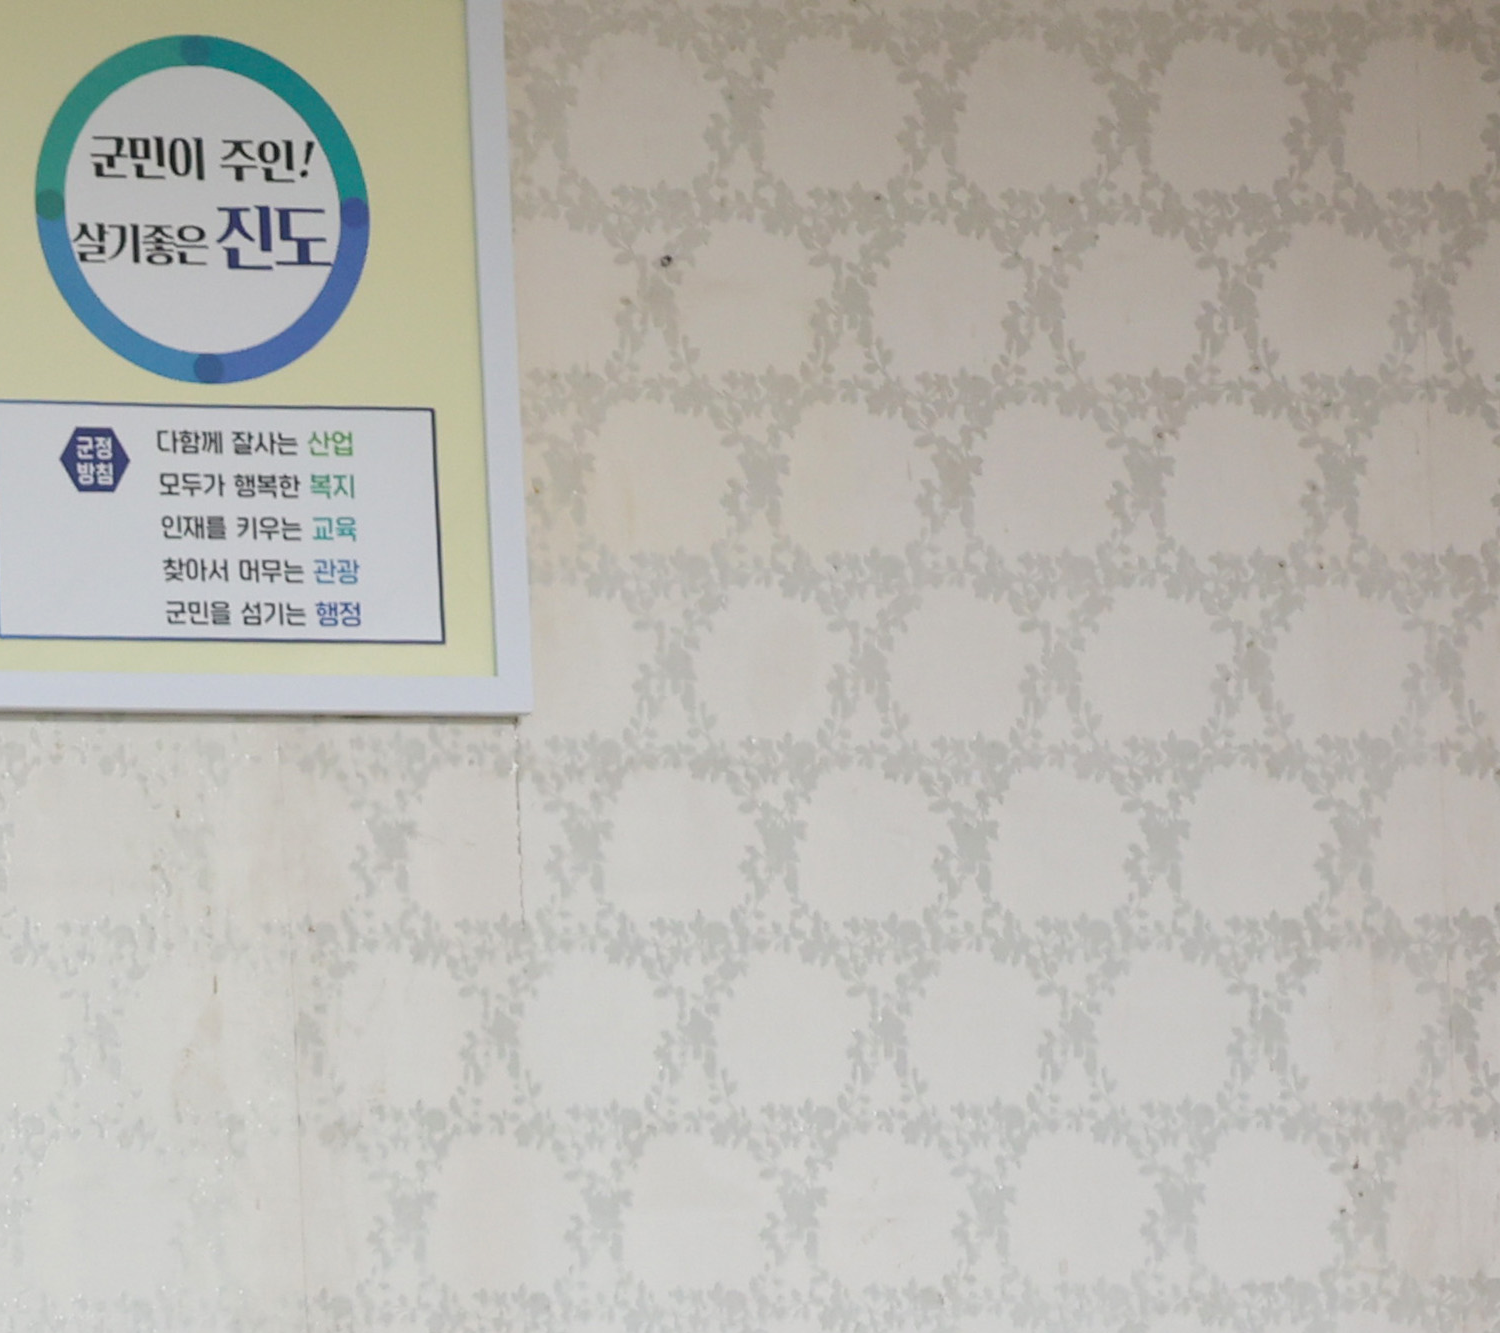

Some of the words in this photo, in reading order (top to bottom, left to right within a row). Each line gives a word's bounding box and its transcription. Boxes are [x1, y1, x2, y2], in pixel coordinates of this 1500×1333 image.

[90, 136, 205, 181] 군민이
[221, 139, 316, 184] 주인!
[71, 223, 208, 267] 살기좋은
[216, 205, 333, 271] 진도
[75, 435, 113, 460] 군정
[156, 431, 224, 456] 다함께
[232, 432, 299, 456] 잘사는
[307, 431, 354, 457] 산업
[75, 462, 114, 486] 방침
[159, 473, 226, 498] 모두가
[234, 474, 300, 500] 행복한
[309, 474, 356, 500] 복지
[161, 515, 227, 541] 인재를
[236, 516, 303, 542] 키우는
[312, 517, 358, 543] 교육
[163, 557, 229, 583] 찾아서
[239, 559, 305, 584] 머무는
[313, 559, 360, 586] 관광
[165, 601, 231, 626] 군민을
[241, 602, 307, 627] 섬기는
[315, 602, 362, 627] 행정
